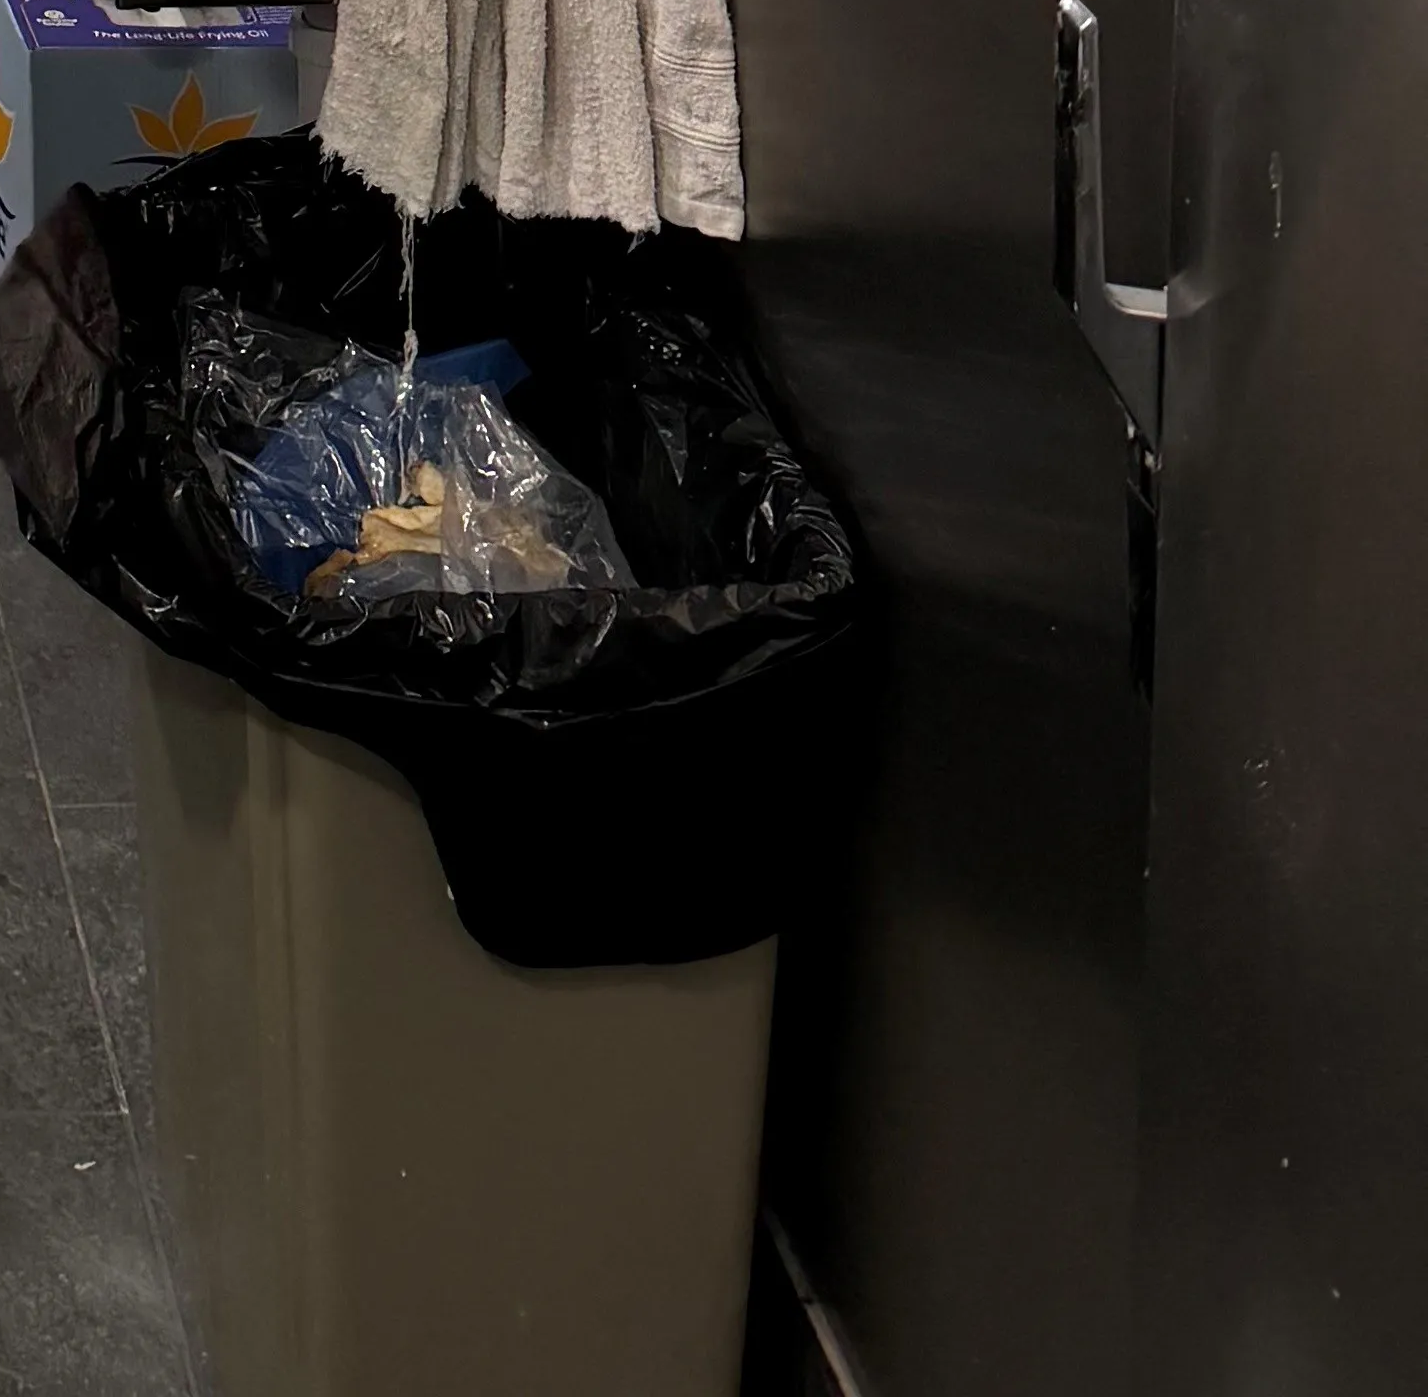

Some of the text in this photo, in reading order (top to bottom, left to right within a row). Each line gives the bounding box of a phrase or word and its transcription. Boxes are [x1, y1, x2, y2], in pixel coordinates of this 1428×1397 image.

[93, 30, 121, 39] The
[198, 30, 245, 41] Frying
[247, 29, 269, 39] Oil
